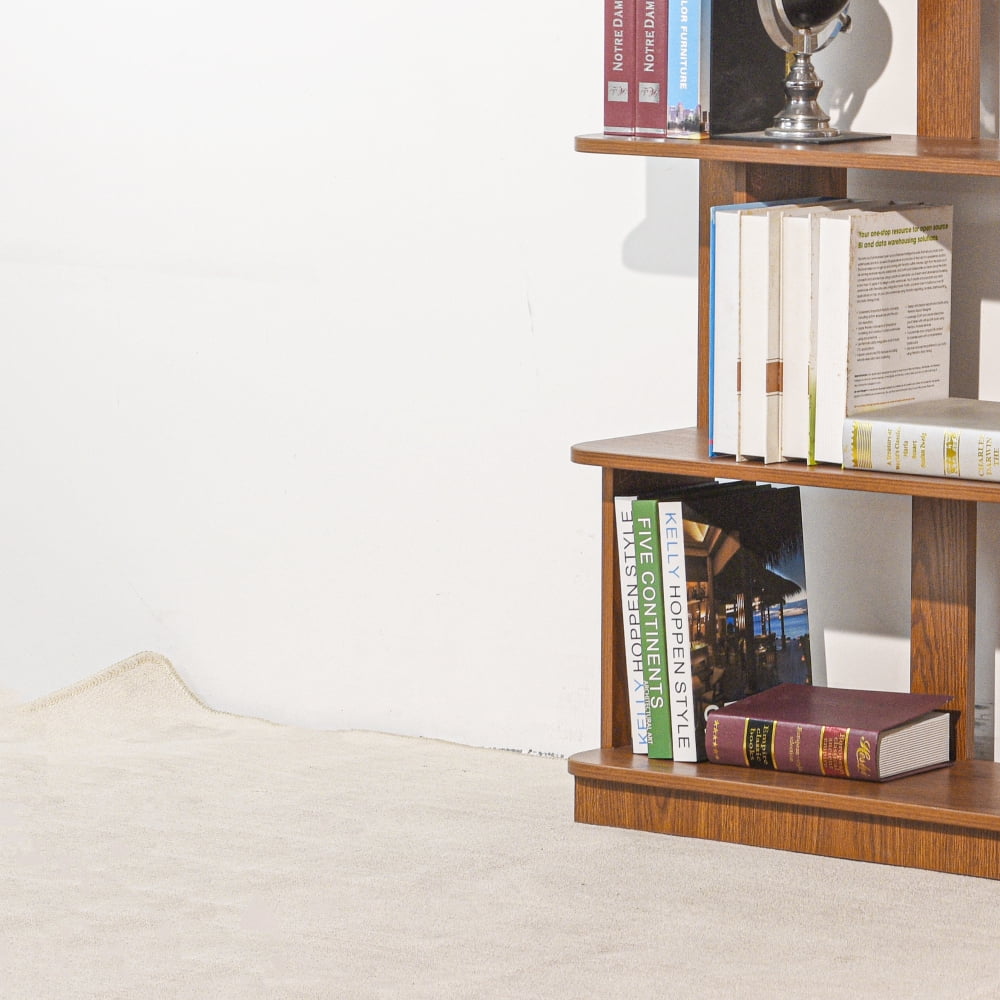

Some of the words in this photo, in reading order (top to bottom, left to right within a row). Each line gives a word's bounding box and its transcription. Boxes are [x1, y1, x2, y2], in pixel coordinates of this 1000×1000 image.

[612, 27, 624, 72] NOTRE
[643, 28, 655, 73] NOTRE
[679, 26, 688, 90] FURNITURE
[858, 230, 870, 238] Your
[870, 228, 891, 238] one-stop
[891, 227, 912, 236] resource
[920, 225, 933, 233] open
[933, 223, 949, 231] source
[864, 241, 875, 249] and
[875, 240, 887, 248] data
[887, 238, 917, 247] warehousing
[621, 510, 638, 577] STYLE
[637, 518, 654, 564] FIVE
[665, 512, 680, 578] KELLY
[627, 584, 645, 673] HOPPEN
[641, 570, 664, 709] CONTINENTS
[669, 585, 685, 675] HOPPEN
[643, 680, 652, 731] ARCHITECTURAL
[674, 681, 690, 749] STYLE
